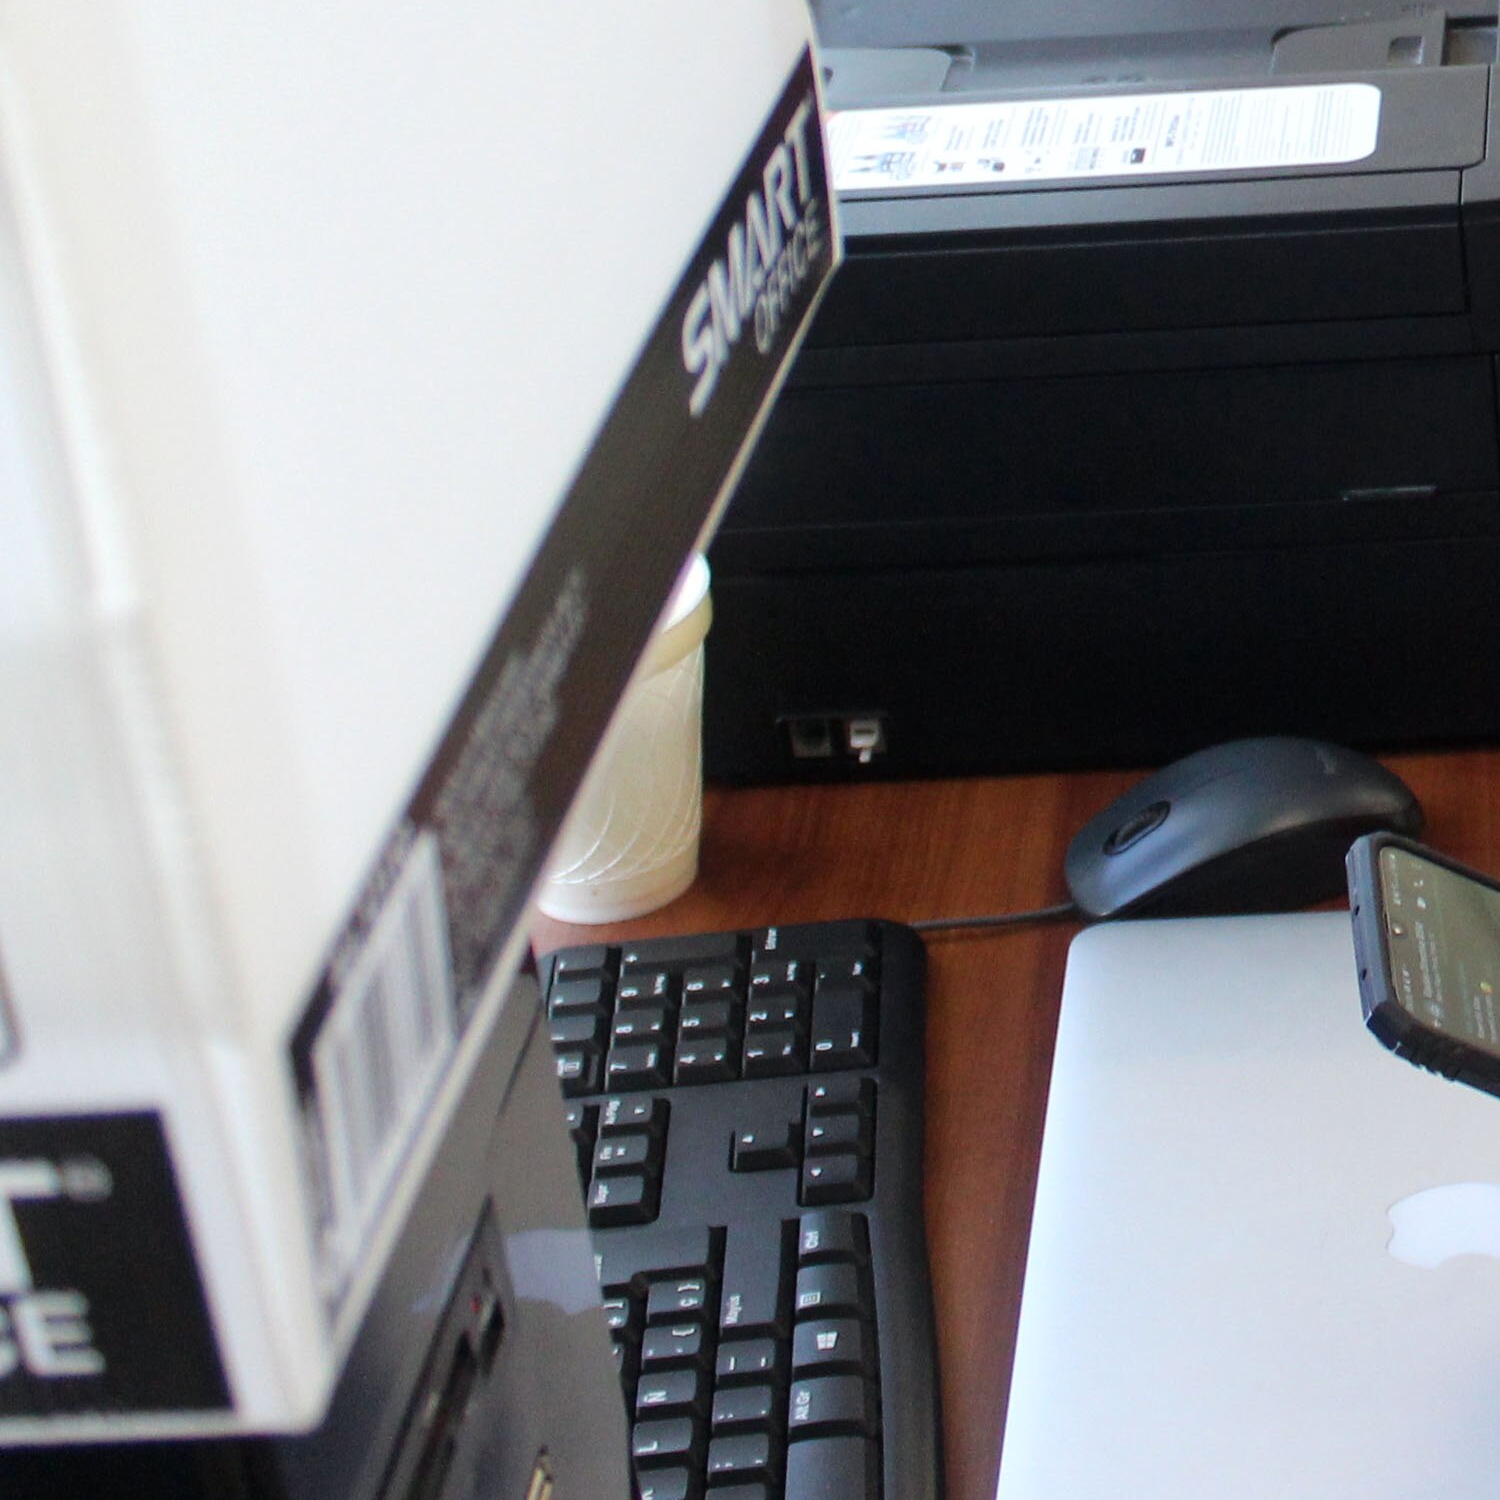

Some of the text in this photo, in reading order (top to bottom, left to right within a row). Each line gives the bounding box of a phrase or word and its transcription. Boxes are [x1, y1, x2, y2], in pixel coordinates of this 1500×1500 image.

[681, 97, 812, 418] SMART
[753, 198, 825, 355] OFFICE
[752, 975, 771, 986] 3
[686, 981, 704, 992] 6
[620, 987, 638, 998] 9
[749, 1011, 768, 1022] 2
[682, 1018, 700, 1028] 5
[615, 1024, 633, 1034] 8
[815, 1041, 833, 1052] 0
[679, 1054, 697, 1064] 4
[747, 1049, 764, 1059] 1
[610, 1062, 627, 1072] 7
[804, 1230, 820, 1250] Ctrl
[644, 1390, 667, 1404] Ñ
[793, 1390, 811, 1421] Alt Gr
[637, 1441, 658, 1454] L
